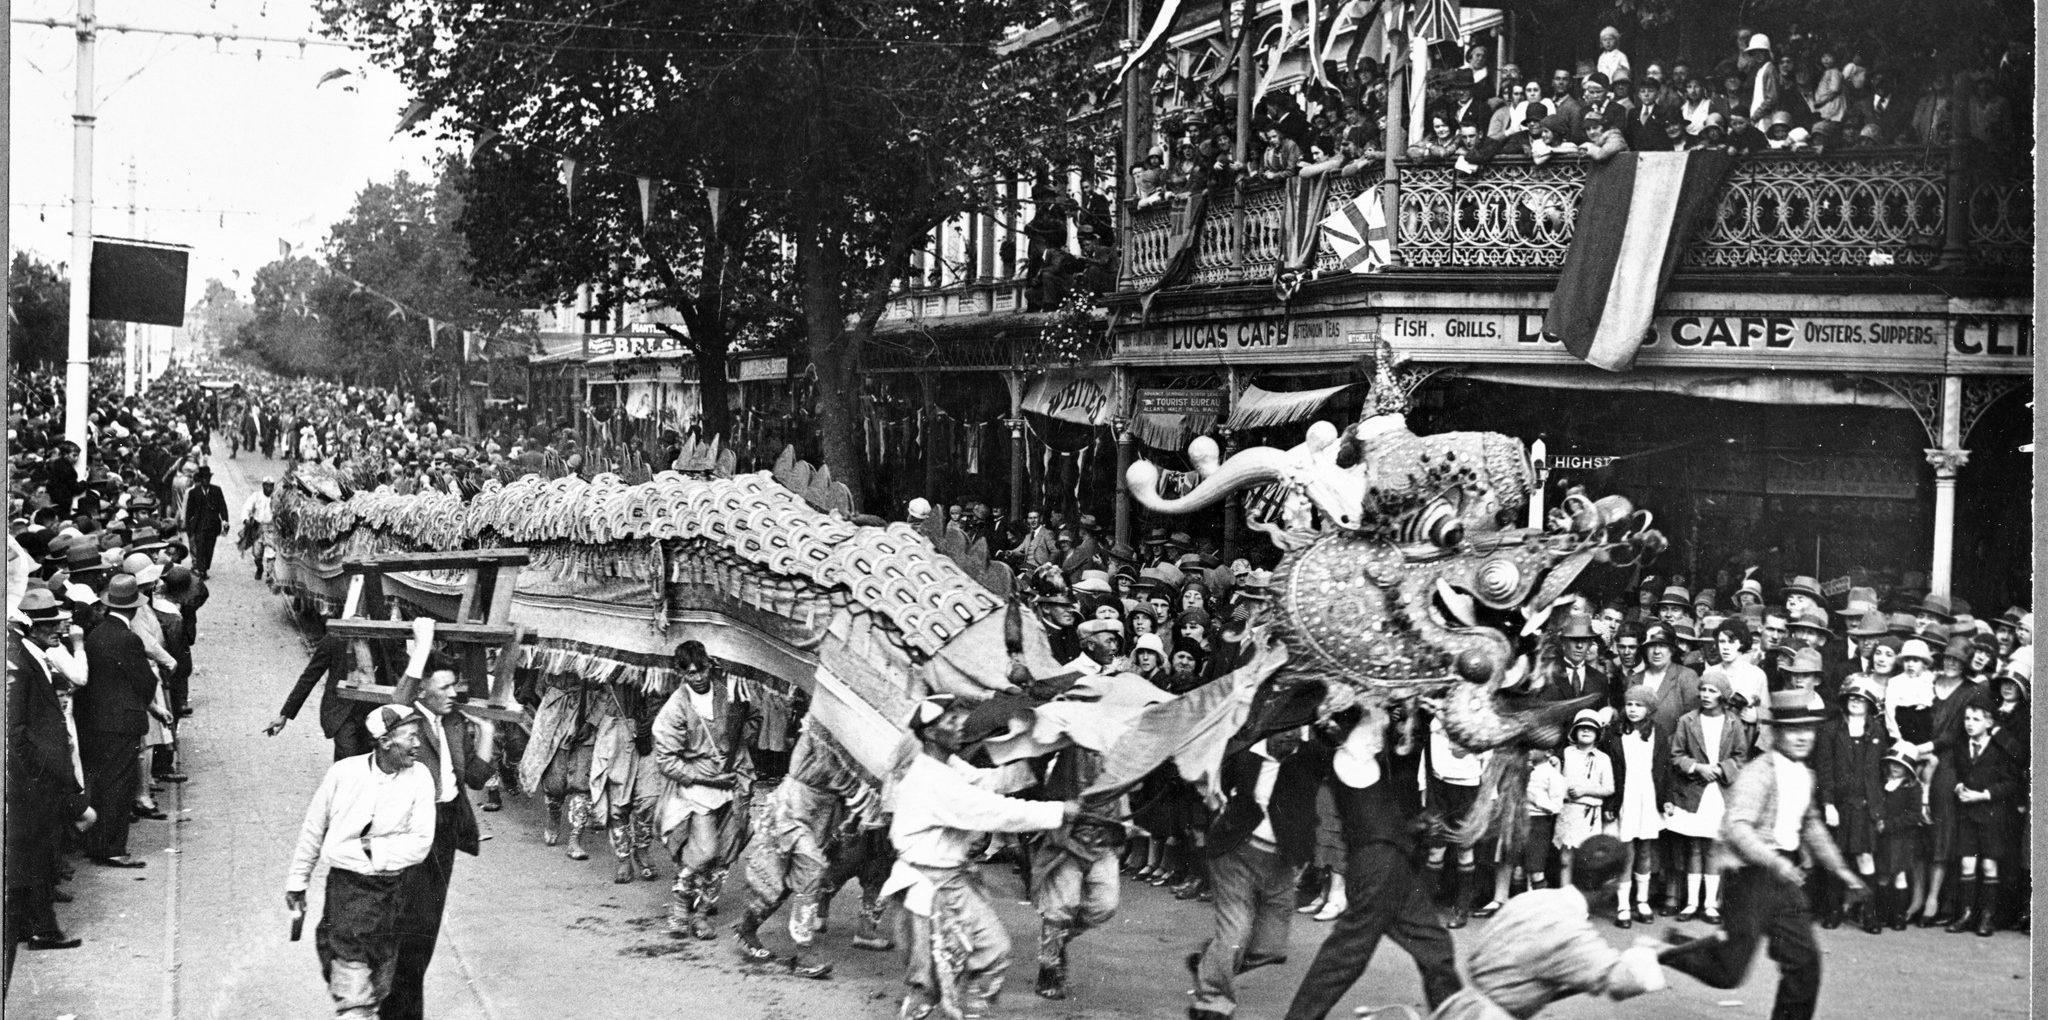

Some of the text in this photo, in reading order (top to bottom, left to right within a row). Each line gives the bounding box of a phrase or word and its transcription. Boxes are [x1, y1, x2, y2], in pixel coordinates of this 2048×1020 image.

[1172, 321, 1228, 350] LUCAS
[1237, 317, 1290, 347] CAFE
[1292, 319, 1341, 339] AFTERNOON TEAS
[1671, 317, 1795, 348] CAFE
[1953, 317, 2033, 356] CLI
[1156, 398, 1221, 407] TOURIST BUREAU
